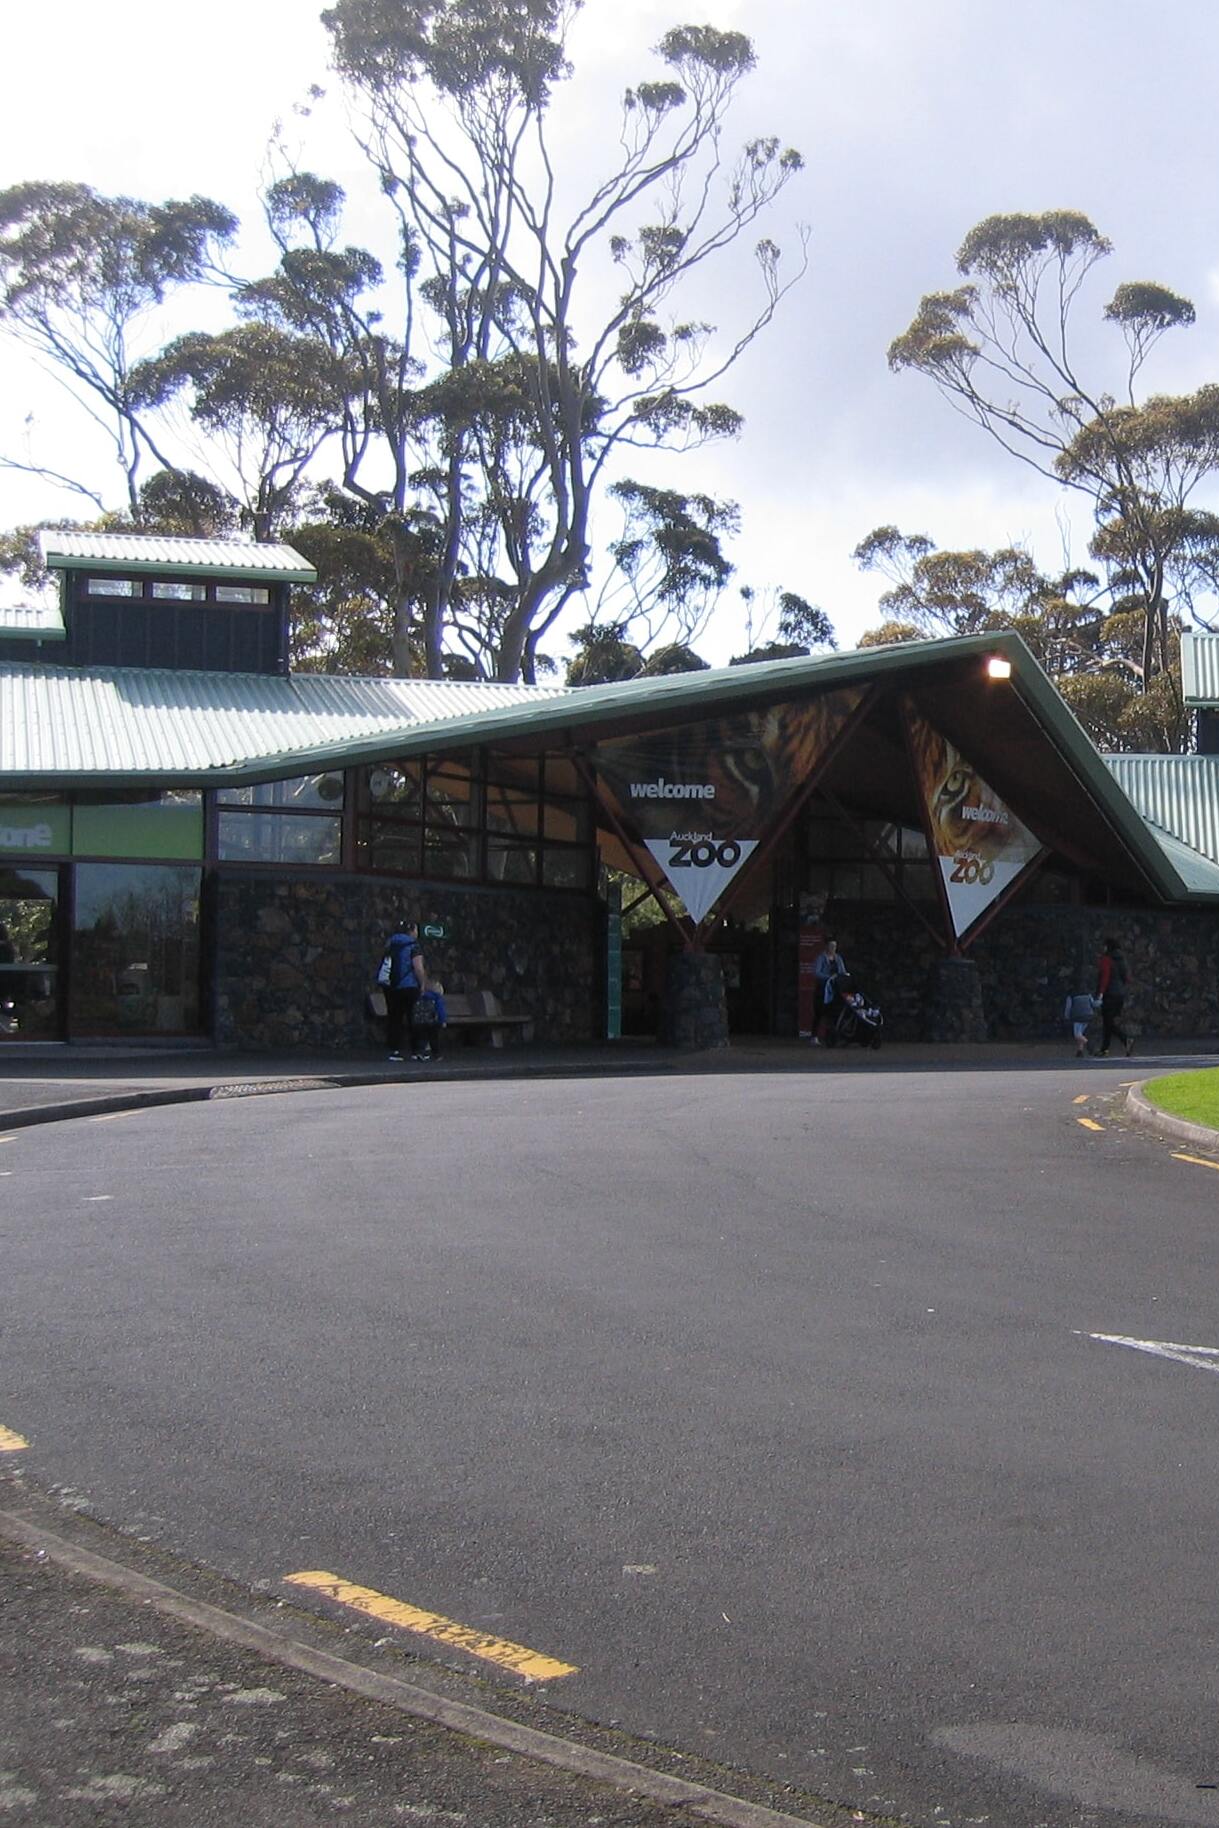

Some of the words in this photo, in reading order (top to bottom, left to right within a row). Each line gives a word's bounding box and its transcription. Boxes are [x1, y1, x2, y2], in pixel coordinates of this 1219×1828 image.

[630, 777, 716, 799] welcome
[961, 803, 1009, 825] welcome
[670, 831, 713, 842] Auckland
